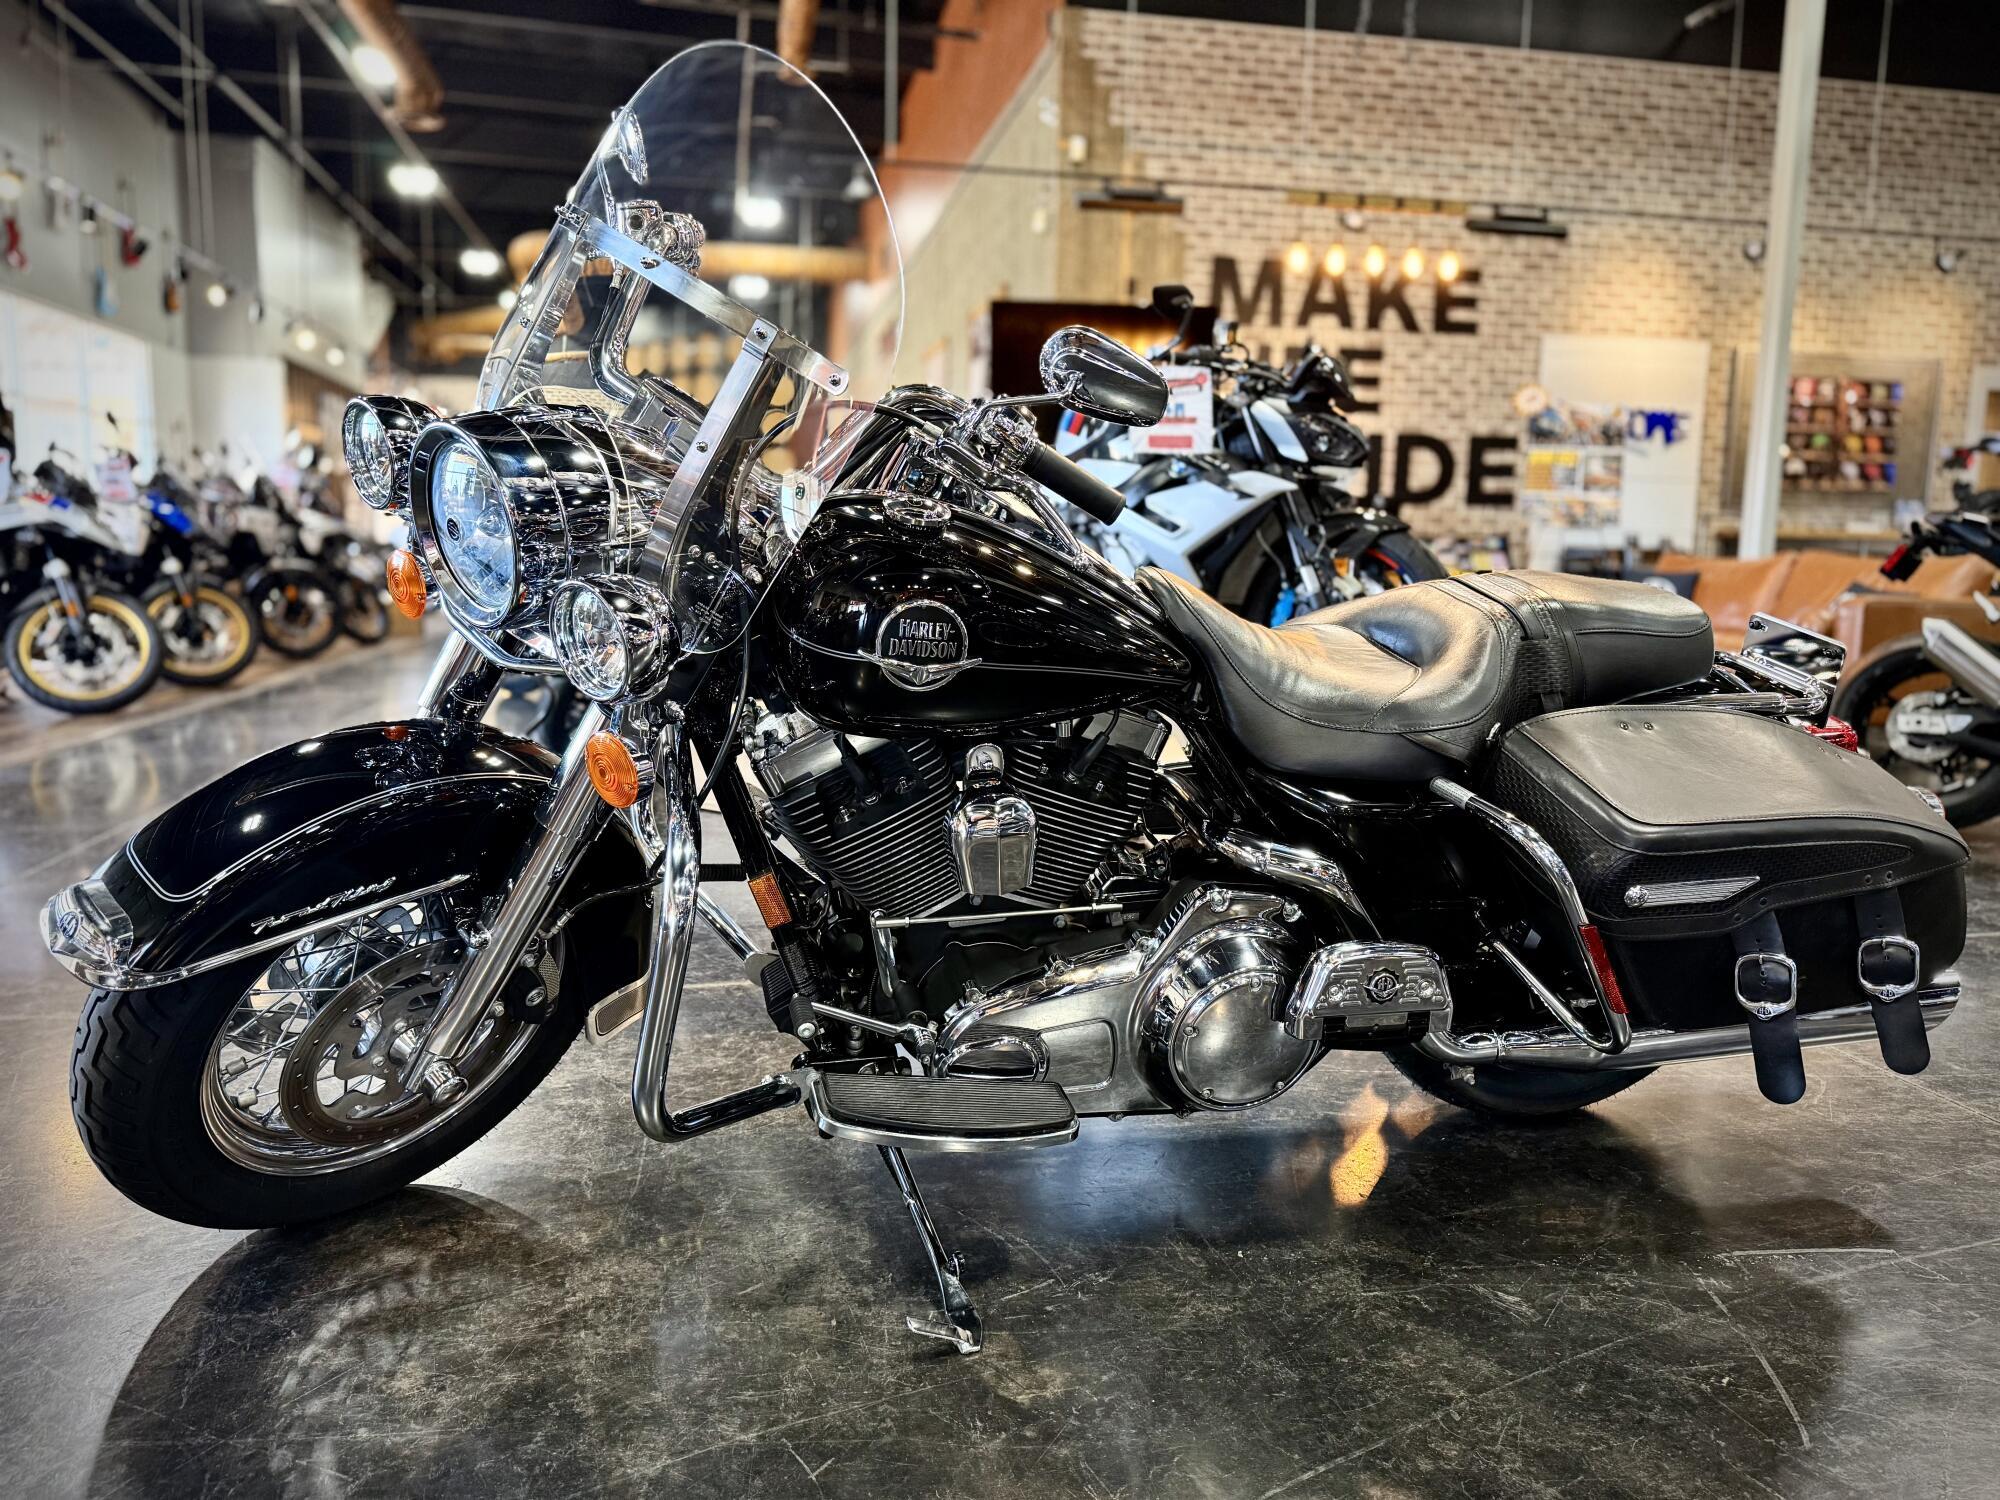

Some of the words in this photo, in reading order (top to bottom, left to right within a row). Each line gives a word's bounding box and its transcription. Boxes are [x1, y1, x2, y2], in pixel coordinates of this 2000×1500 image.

[1211, 257, 1481, 334] MAKE
[1364, 434, 1518, 506] IDE
[888, 638, 958, 659] DAVIDSON
